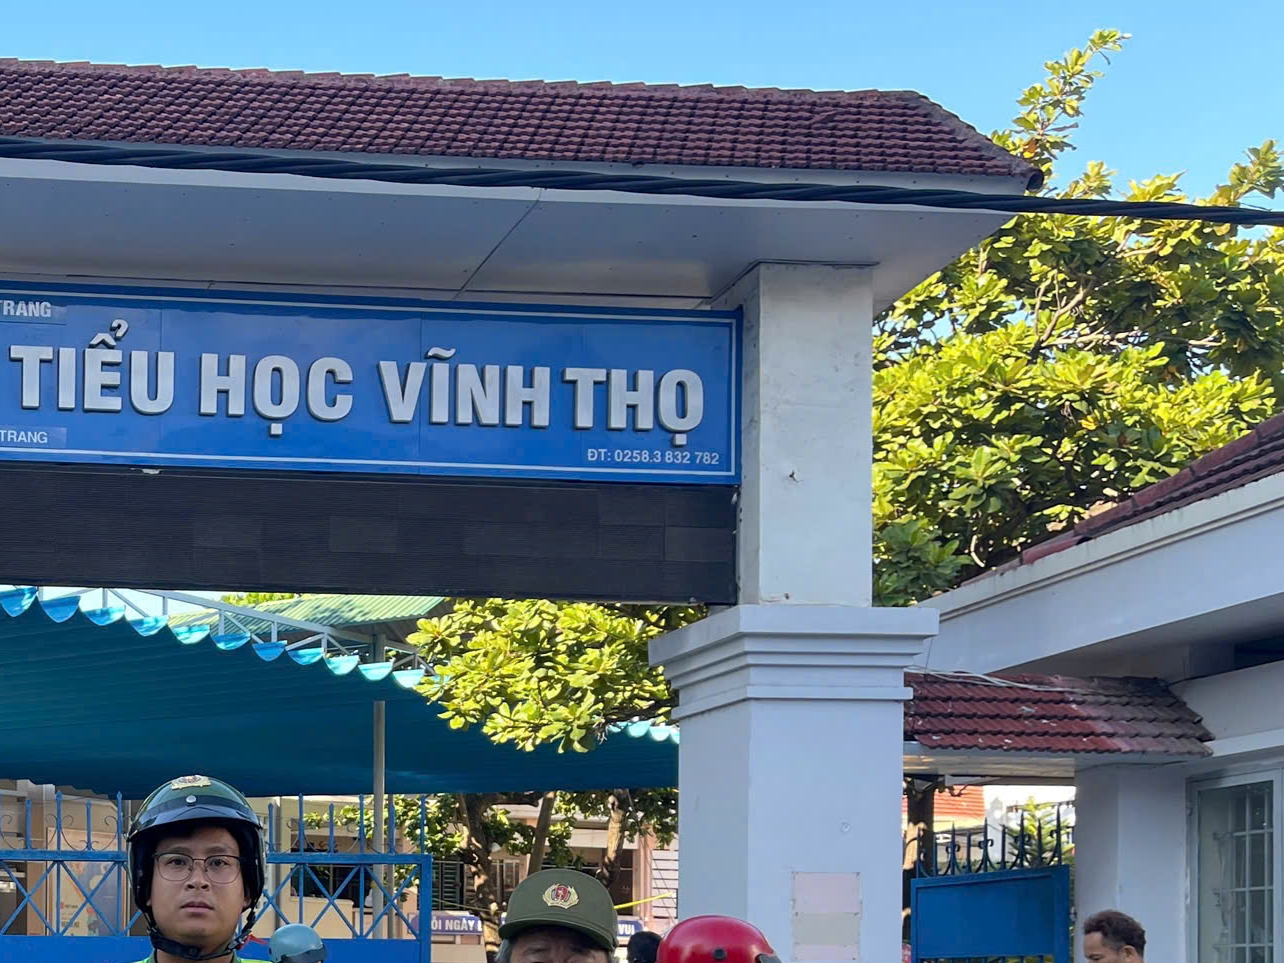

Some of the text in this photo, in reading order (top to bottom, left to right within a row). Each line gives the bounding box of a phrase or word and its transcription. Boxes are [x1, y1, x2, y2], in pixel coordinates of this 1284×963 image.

[9, 319, 175, 415] TIỂU
[199, 352, 353, 436] HỌC
[378, 347, 551, 428] VĨNH
[563, 367, 704, 446] THỌ
[587, 448, 720, 465] ĐT: 0258.3 832 782
